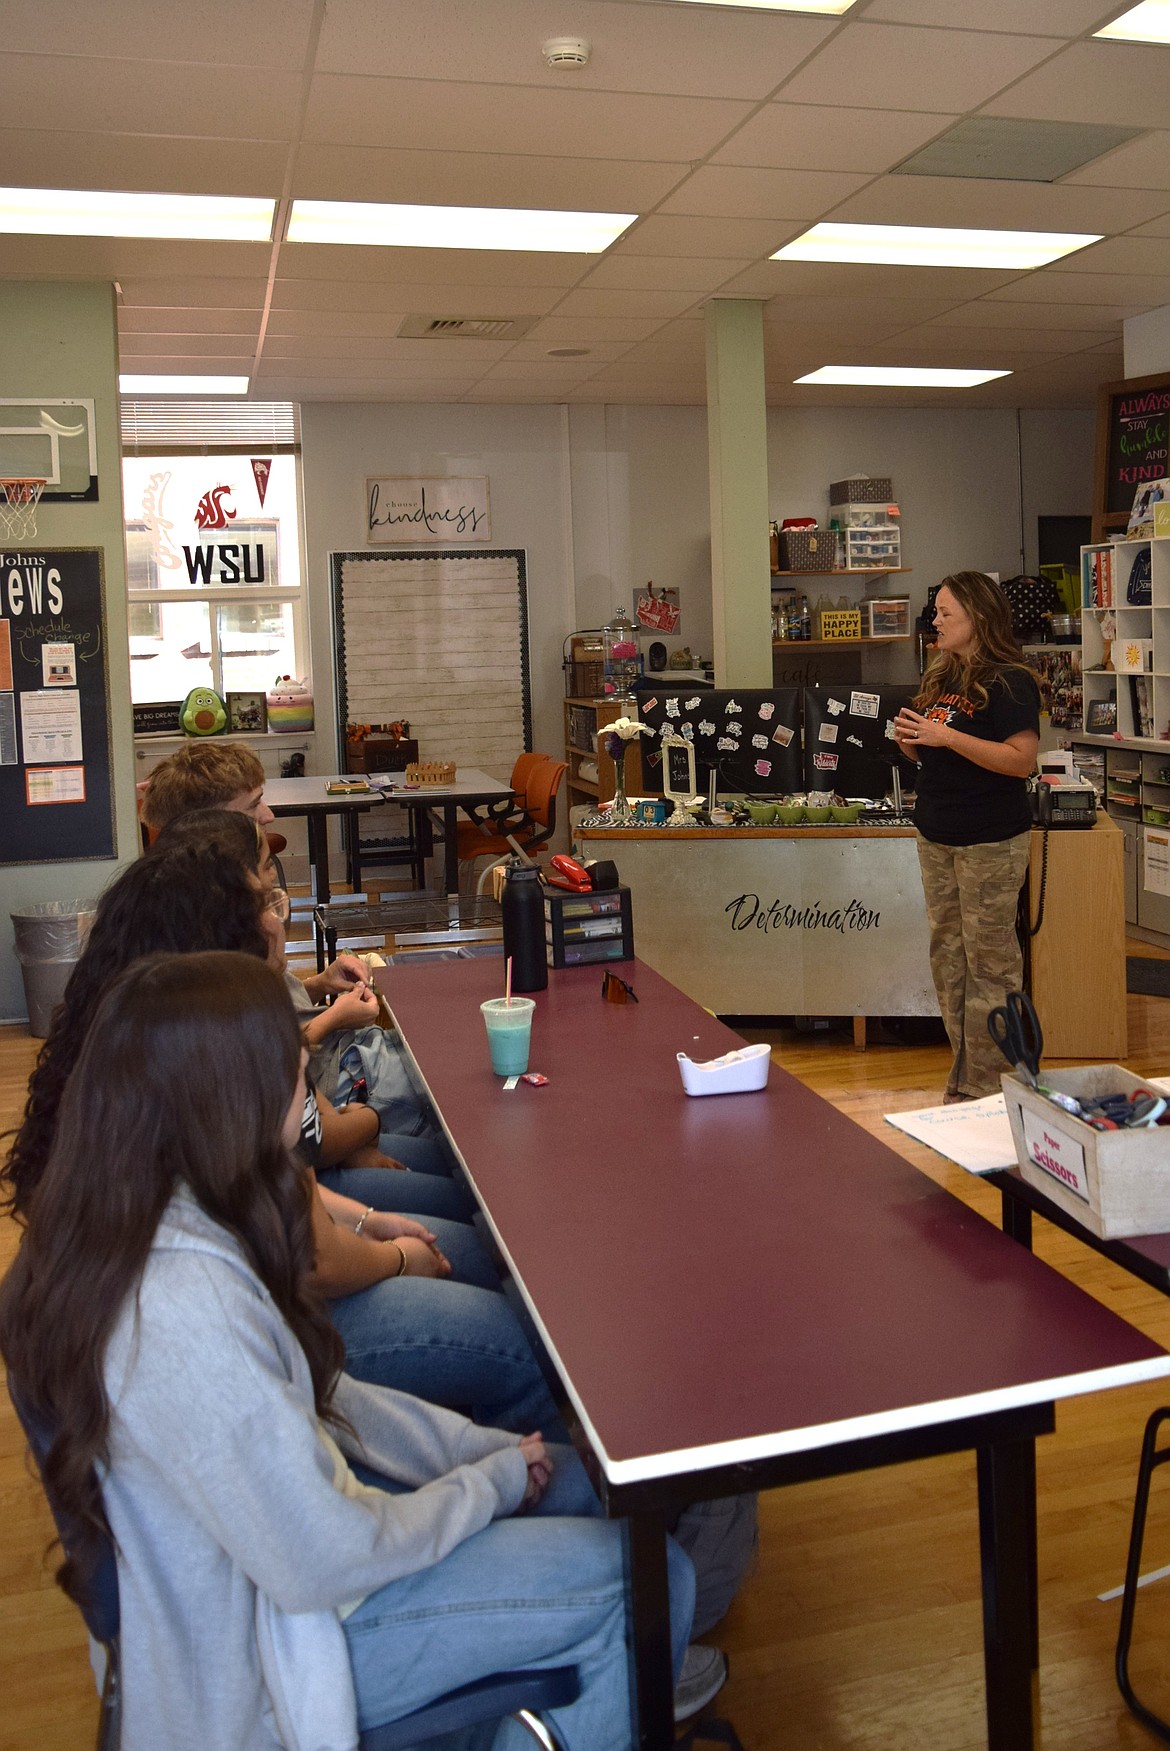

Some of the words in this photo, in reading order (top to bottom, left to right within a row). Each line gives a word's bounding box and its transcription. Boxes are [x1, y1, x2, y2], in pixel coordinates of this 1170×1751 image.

[1120, 393, 1170, 415] ALWAYS
[1127, 420, 1148, 431] STAY
[1146, 449, 1167, 460] AND
[1120, 465, 1164, 483] KIND
[369, 484, 486, 533] kindness
[0, 553, 46, 568] Johns
[181, 543, 265, 584] WSU
[0, 567, 63, 616] ews
[823, 620, 859, 629] HAPPY
[824, 629, 859, 638] PLACE
[143, 712, 155, 720] BIG
[673, 754, 687, 766] Mrs
[725, 893, 881, 934] Determination
[1033, 1141, 1079, 1189] Scissors
